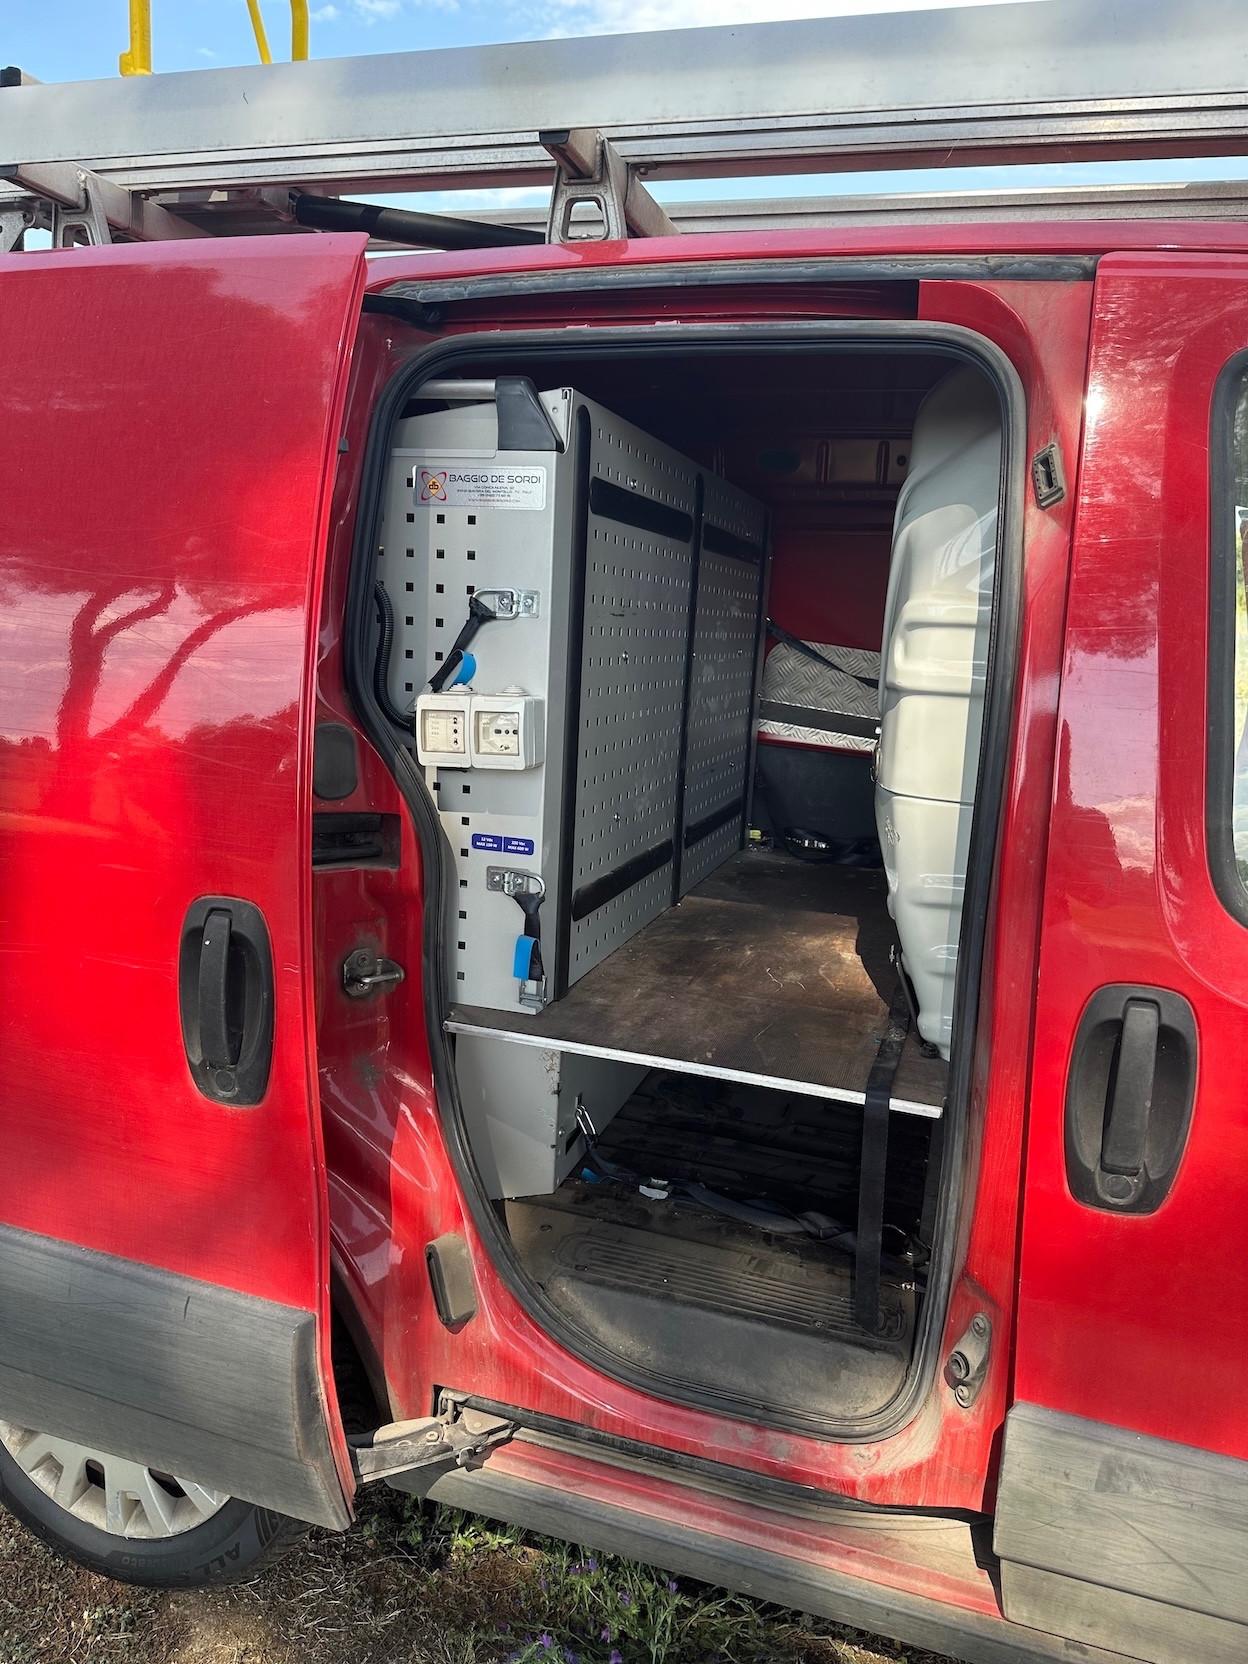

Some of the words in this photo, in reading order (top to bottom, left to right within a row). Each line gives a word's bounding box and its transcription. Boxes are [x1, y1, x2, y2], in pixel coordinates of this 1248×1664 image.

[449, 474, 488, 483] BAGGIO
[491, 475, 504, 483] DE
[507, 475, 541, 484] SORDI
[194, 1541, 240, 1576] ALL
